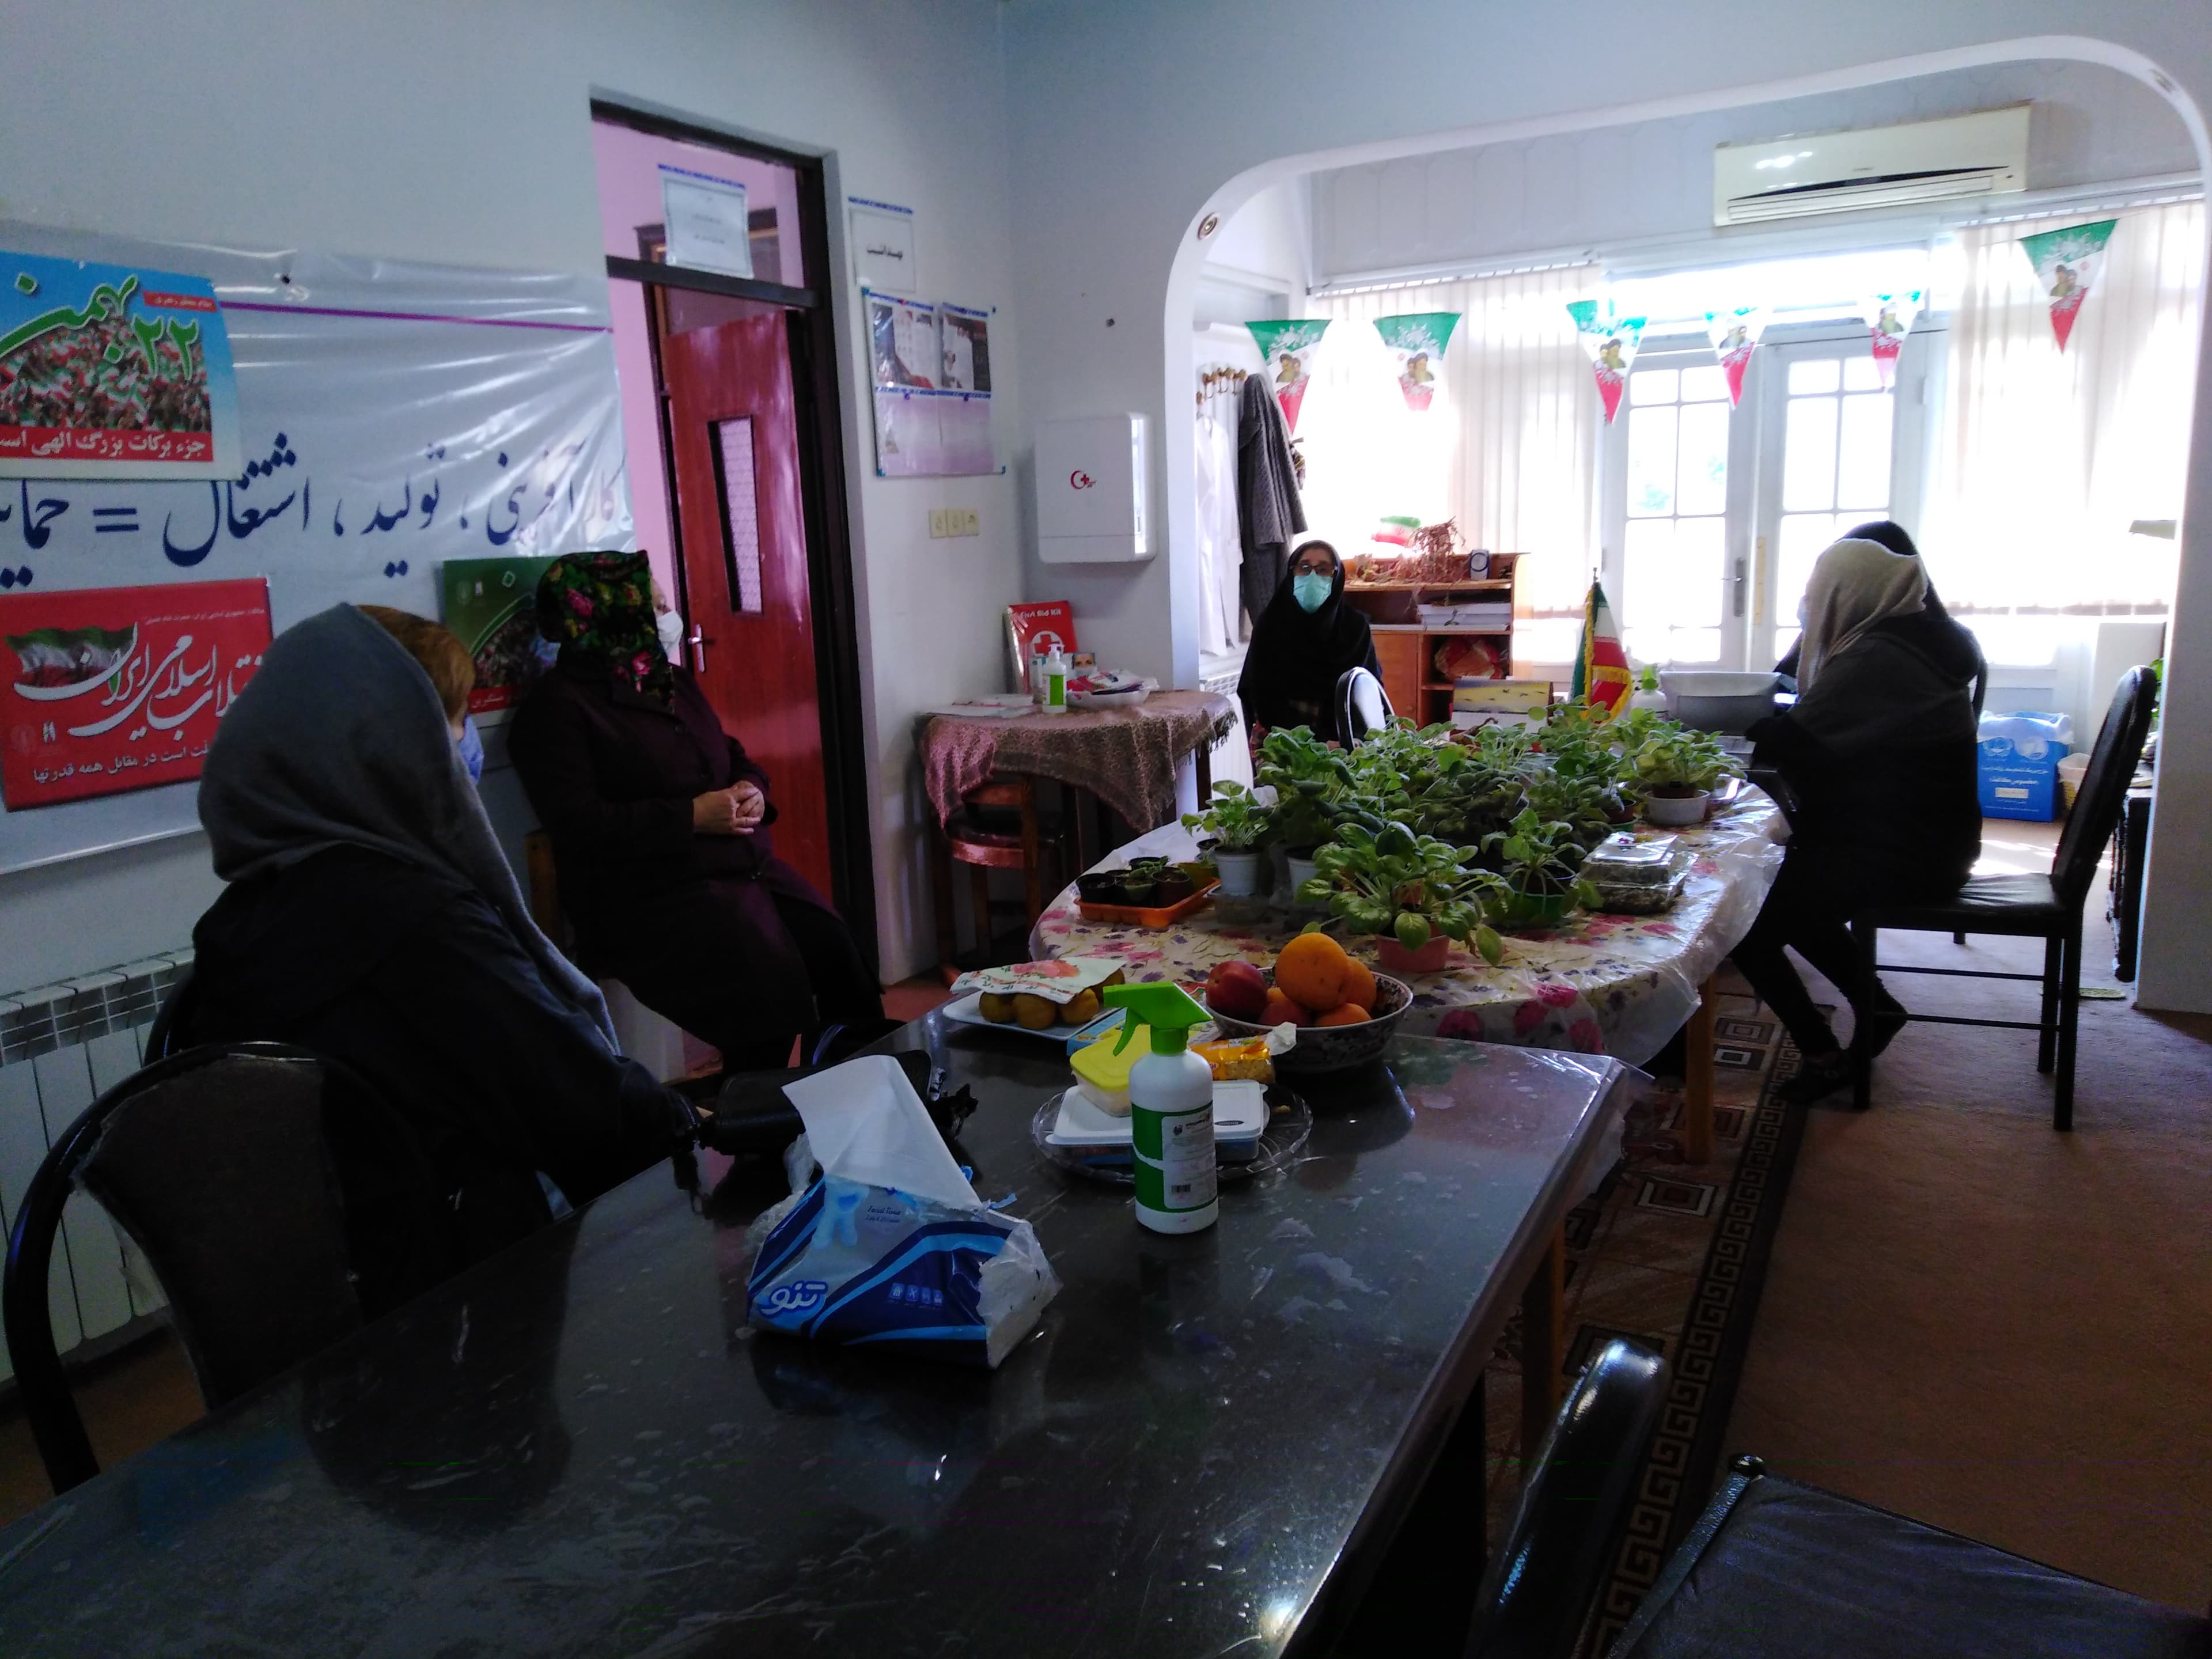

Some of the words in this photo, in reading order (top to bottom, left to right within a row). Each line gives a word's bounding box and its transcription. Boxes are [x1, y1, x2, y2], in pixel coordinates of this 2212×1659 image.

[131, 315, 199, 381] ۲۲
[0, 430, 27, 447] اس
[31, 431, 72, 456] الهی
[75, 432, 123, 457] بزرگ
[128, 433, 171, 458] برکات
[176, 439, 206, 459] جزء
[162, 433, 310, 567] اشتغال
[0, 480, 70, 589] حمای
[13, 622, 151, 707] ایران
[67, 635, 218, 741] اسلامی
[108, 755, 139, 774] مقابل
[142, 753, 157, 767] در
[161, 747, 186, 762] است
[79, 762, 103, 774] همه
[868, 1205, 885, 1214] Facial
[886, 1207, 901, 1215] Tissue
[760, 1282, 827, 1316] تنو
